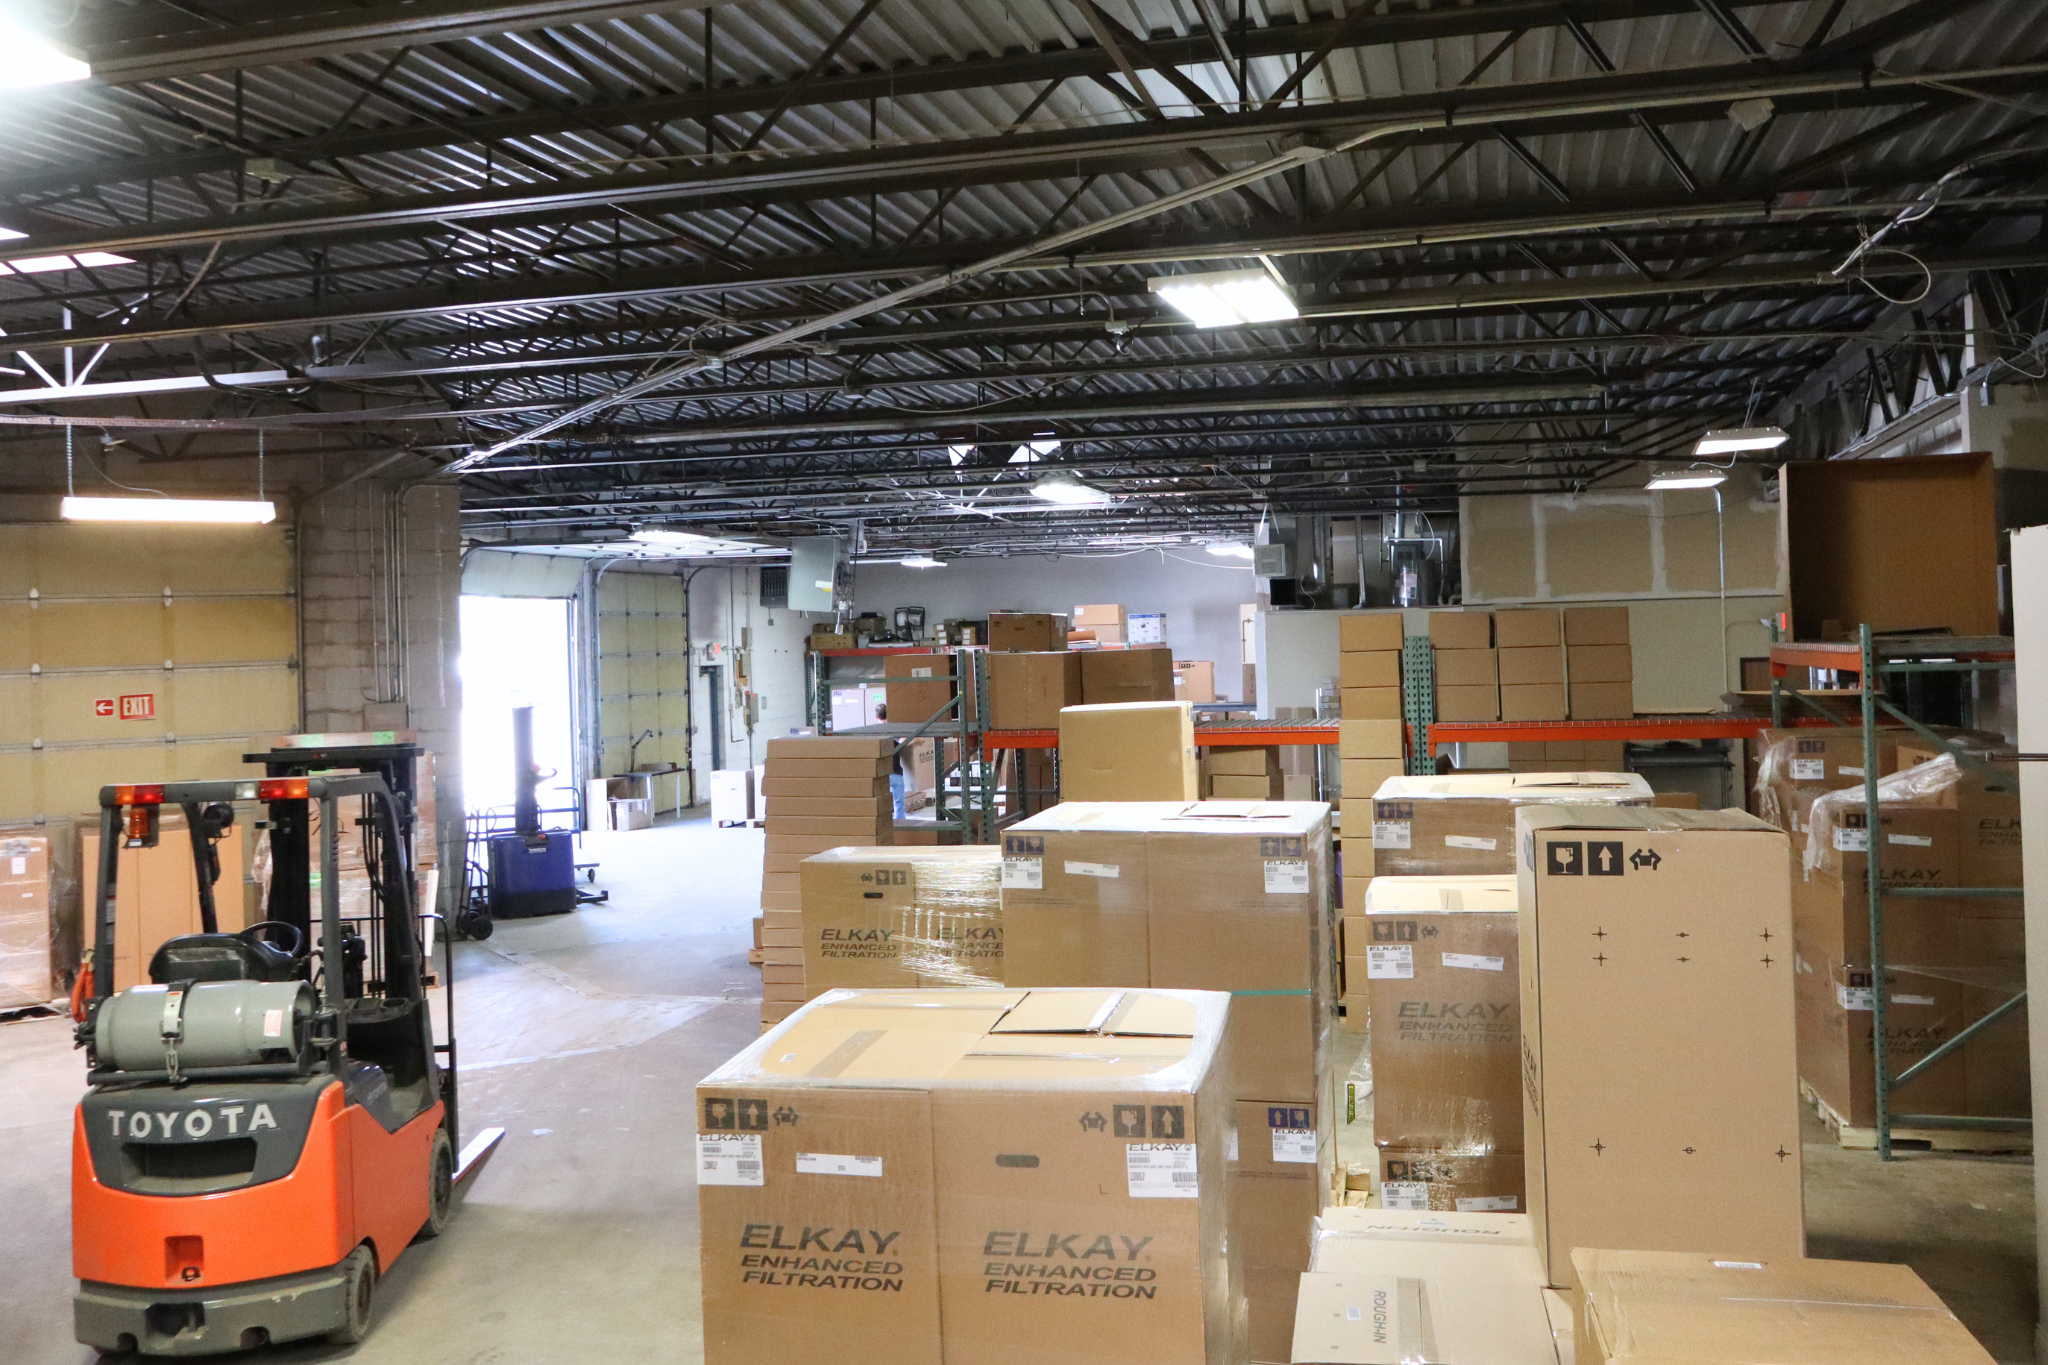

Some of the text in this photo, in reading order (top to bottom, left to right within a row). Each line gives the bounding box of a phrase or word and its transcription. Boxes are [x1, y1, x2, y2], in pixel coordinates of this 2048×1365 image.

[123, 696, 150, 716] EXIT
[820, 928, 895, 942] ELKAY
[821, 942, 897, 951] ENHANCED
[821, 950, 897, 959] FILTRATION
[1398, 1002, 1511, 1019] ELKAY
[1398, 1021, 1513, 1033] ENHANCED
[1400, 1032, 1513, 1043] FILTRATION
[108, 1102, 278, 1139] TOYOTA
[1129, 1143, 1183, 1151] ELKAY
[740, 1224, 902, 1255] ELKAY
[1367, 1225, 1501, 1235] ROUGH-IN
[982, 1231, 1154, 1261] ELKAY
[741, 1254, 904, 1275] ENHANCED
[983, 1262, 1157, 1282] ENHANCED
[743, 1271, 904, 1292] FILTRATION
[985, 1279, 1157, 1300] FILTRATION
[1373, 1290, 1387, 1344] ROUGH-IN
